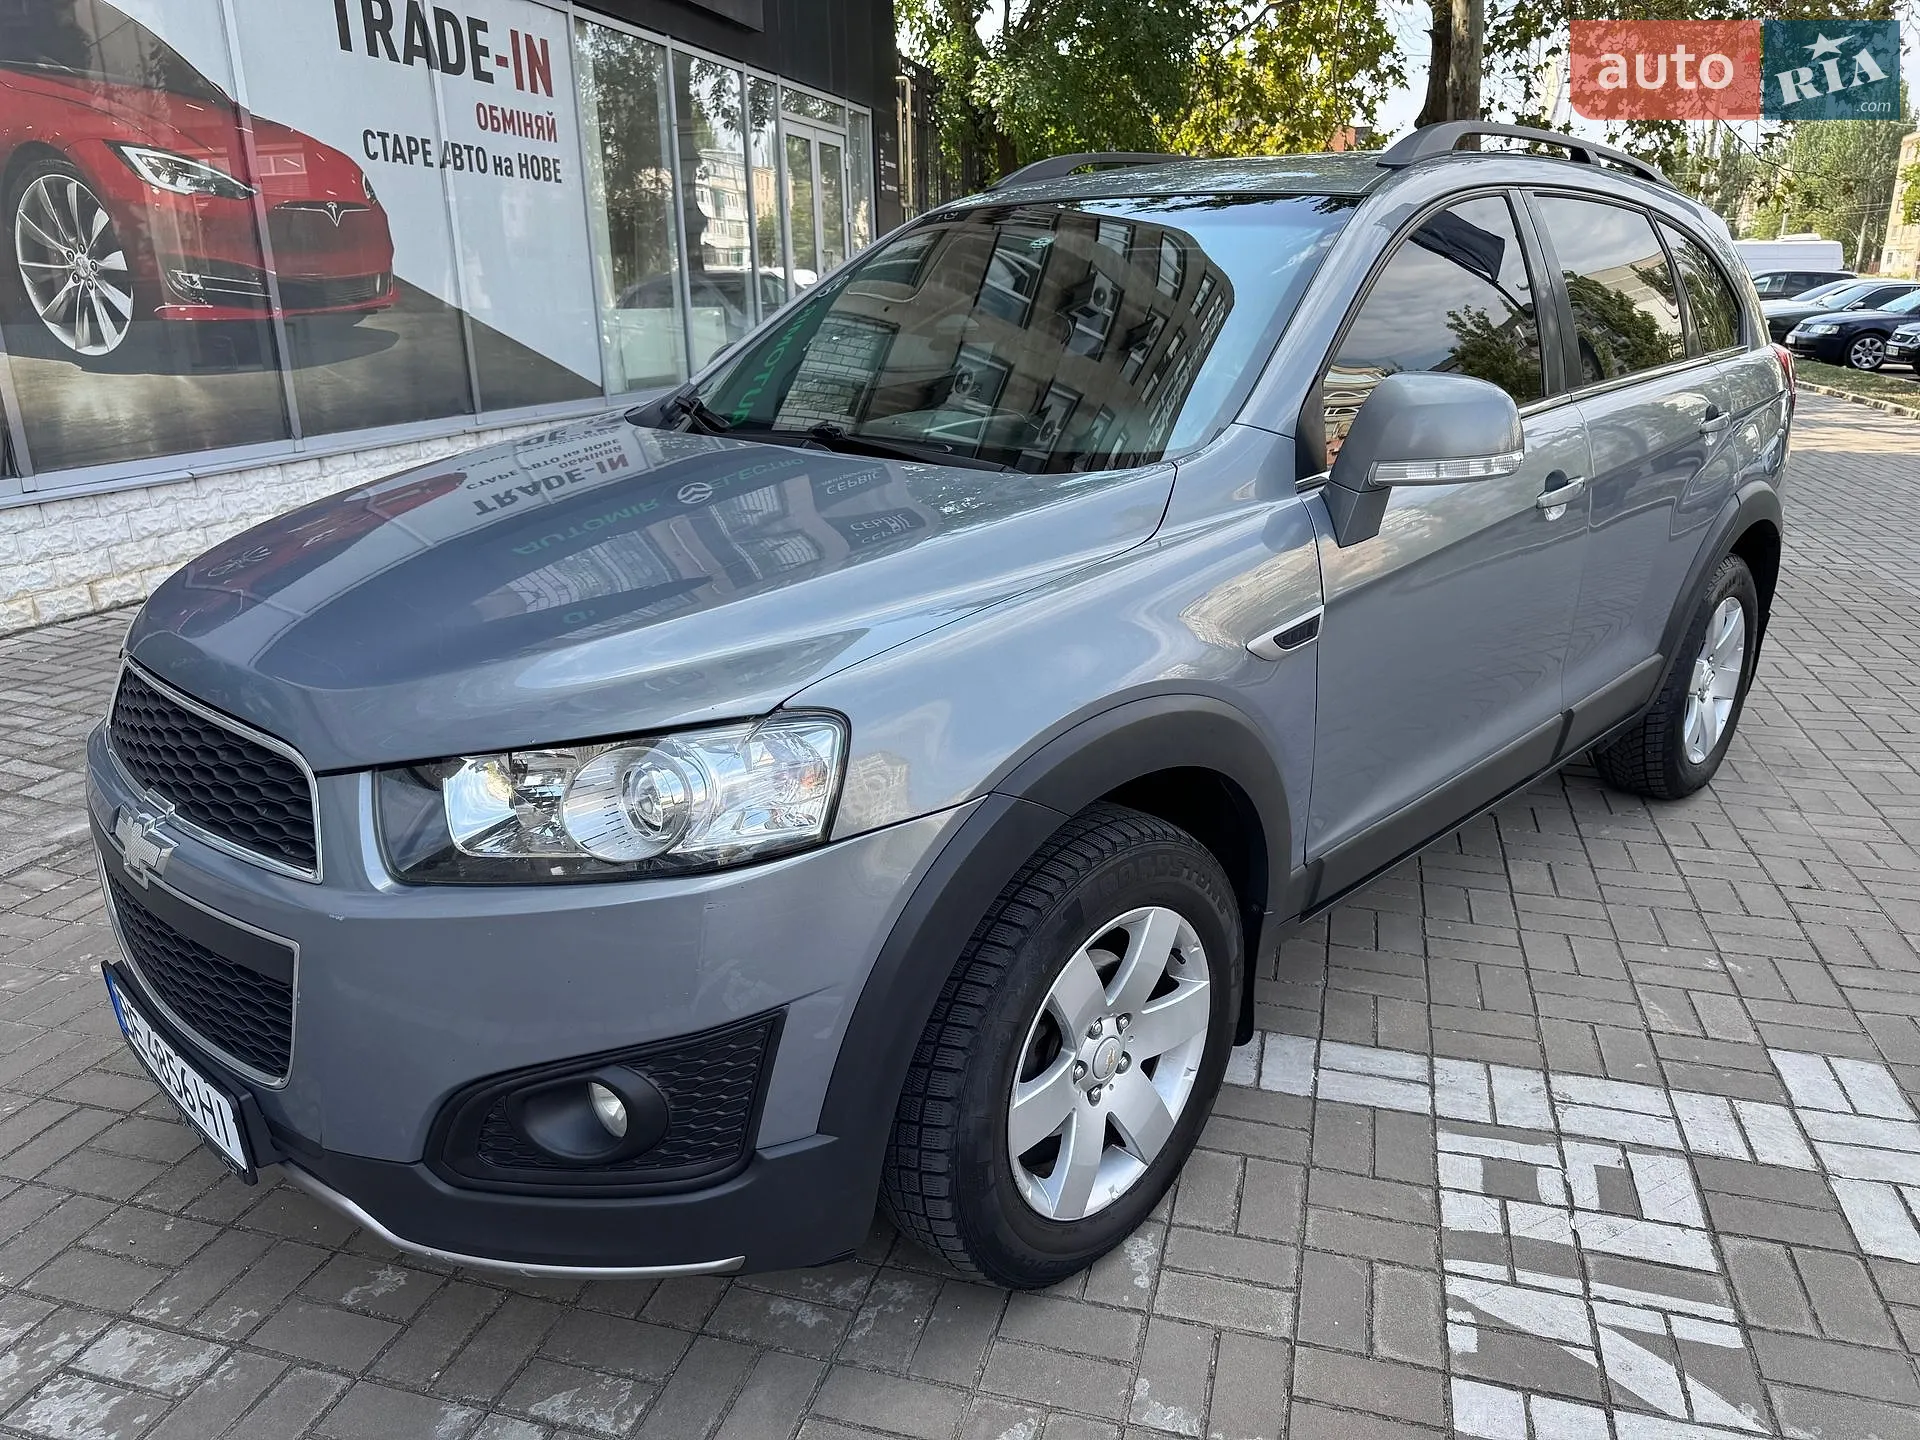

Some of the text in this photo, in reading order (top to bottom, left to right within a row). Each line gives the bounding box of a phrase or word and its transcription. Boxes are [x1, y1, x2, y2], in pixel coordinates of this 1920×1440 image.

[333, 0, 554, 98] TRADE-IN
[475, 102, 558, 143] ОБМІНЯЙ
[362, 129, 563, 184] СТАРЕ АВТО на НОВЕ
